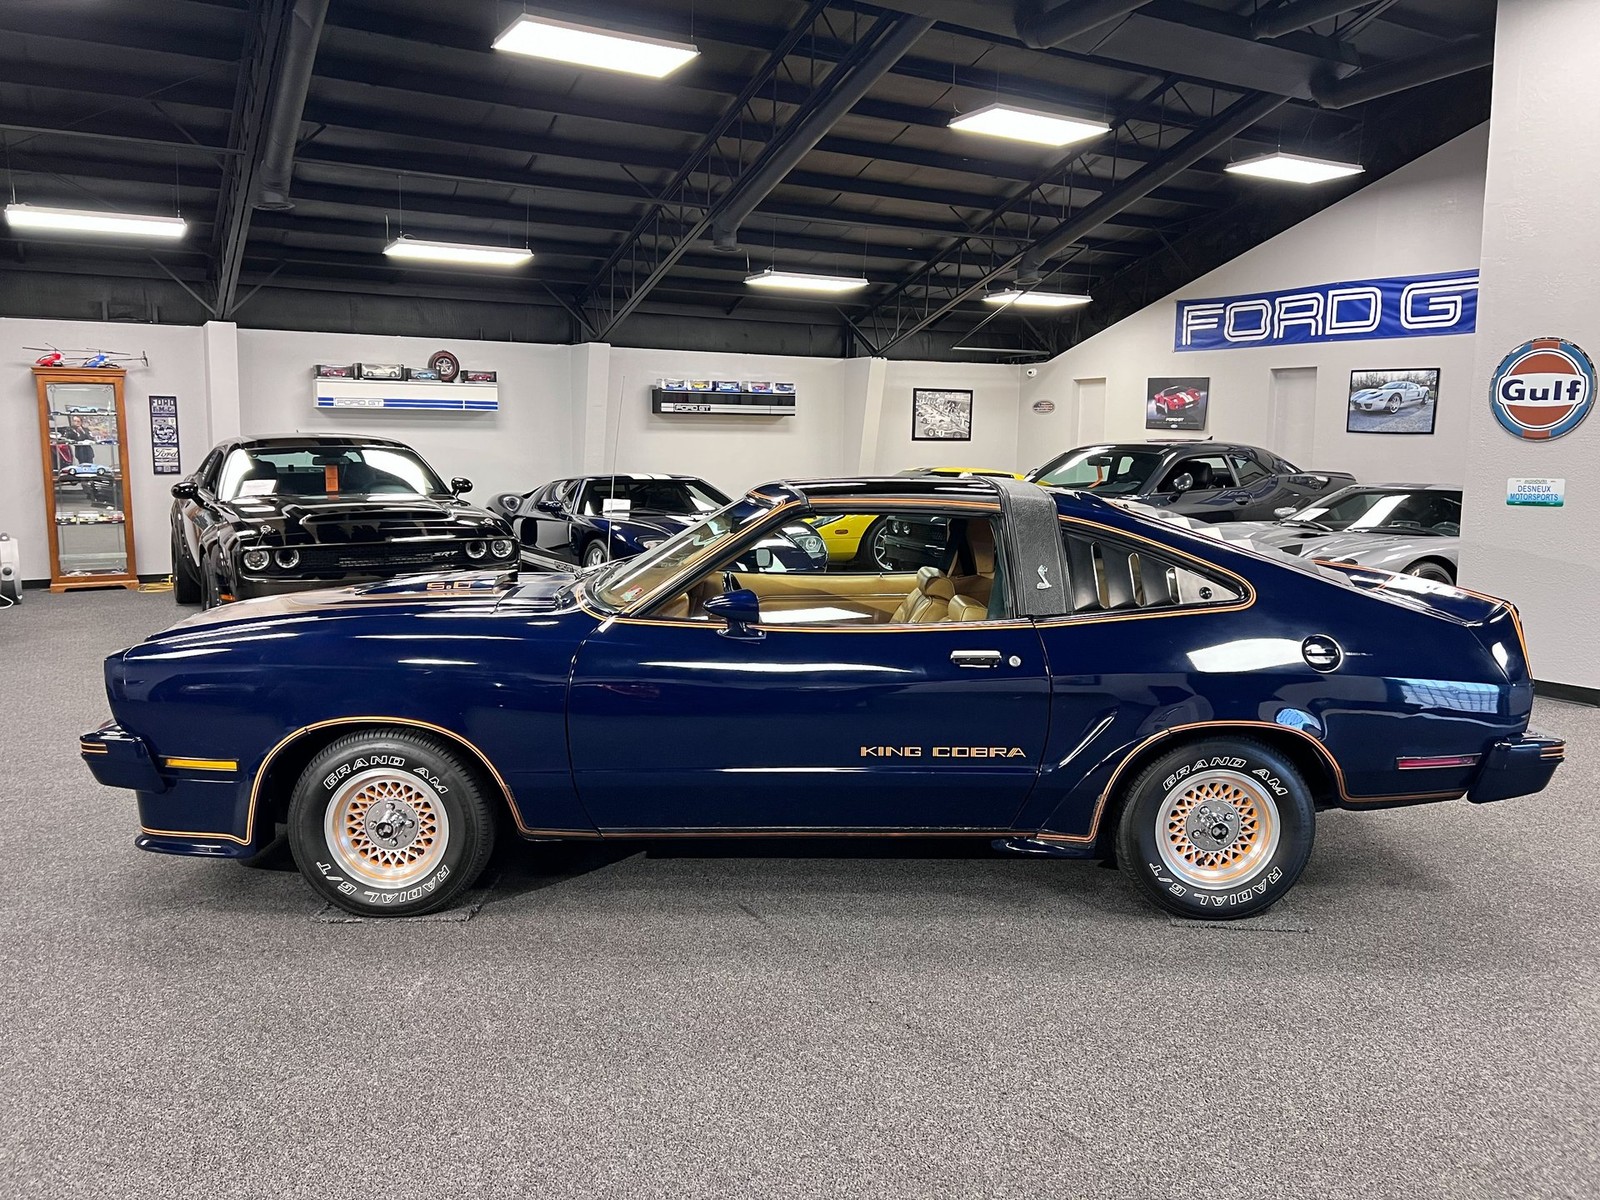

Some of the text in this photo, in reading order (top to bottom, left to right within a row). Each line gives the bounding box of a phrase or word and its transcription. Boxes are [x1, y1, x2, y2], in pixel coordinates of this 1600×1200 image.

[1182, 286, 1383, 346] FORD
[1501, 379, 1582, 401] Gulf
[1510, 493, 1559, 501] MOTORSPORTS
[1517, 485, 1552, 493] DESNEUX
[426, 581, 471, 591] 5.0
[860, 746, 1026, 758] KING COBRA
[323, 755, 448, 794] GRAND AM
[1163, 757, 1288, 796] GRAND AM
[364, 865, 450, 903] RADIAL
[1194, 867, 1283, 906] RADIAL
